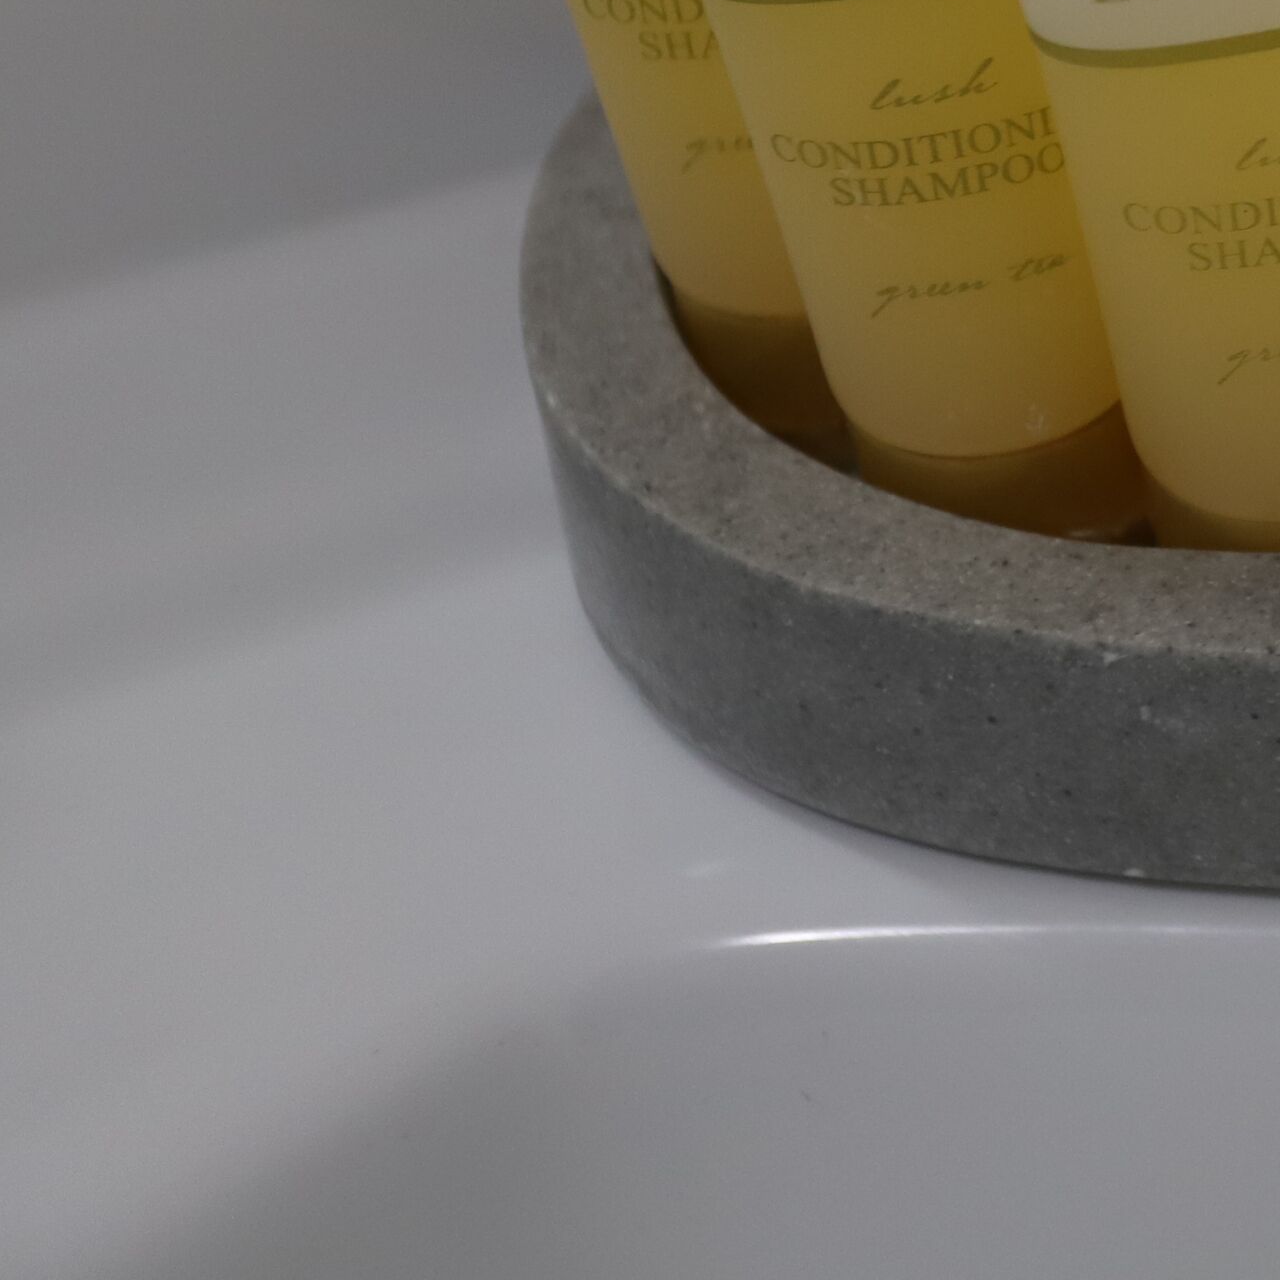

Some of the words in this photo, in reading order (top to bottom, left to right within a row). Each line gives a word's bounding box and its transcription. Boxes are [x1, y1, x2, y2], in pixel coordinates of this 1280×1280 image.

[870, 56, 998, 111] lush
[769, 106, 1058, 170] CONDITIONI
[829, 141, 1066, 207] SHAMPOO
[871, 278, 991, 318] green
